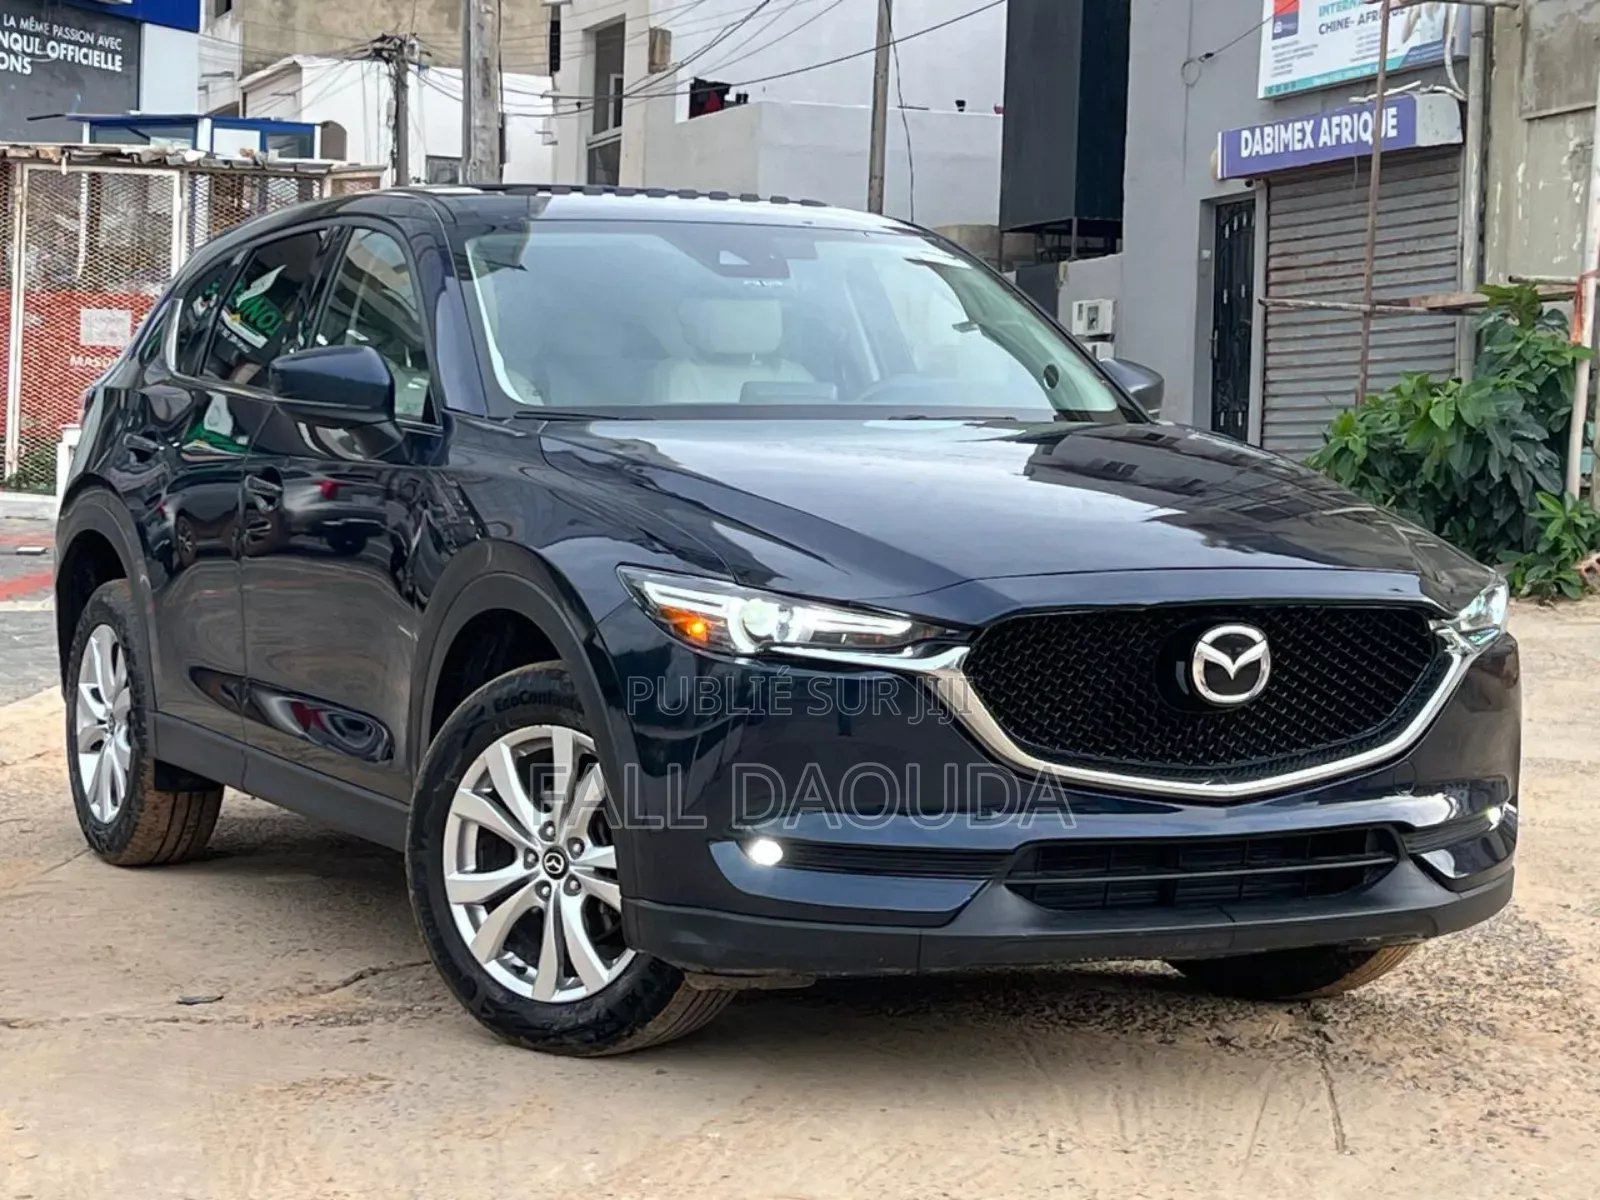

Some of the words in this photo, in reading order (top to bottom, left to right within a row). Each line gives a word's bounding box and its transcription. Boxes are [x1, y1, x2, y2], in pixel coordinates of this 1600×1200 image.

[3, 13, 16, 28] LA
[20, 16, 50, 35] MÊME
[52, 24, 94, 45] PASSION
[97, 35, 122, 51] AVEC
[46, 40, 122, 72] OFFICIELLE
[1240, 119, 1315, 158] DABIMEX
